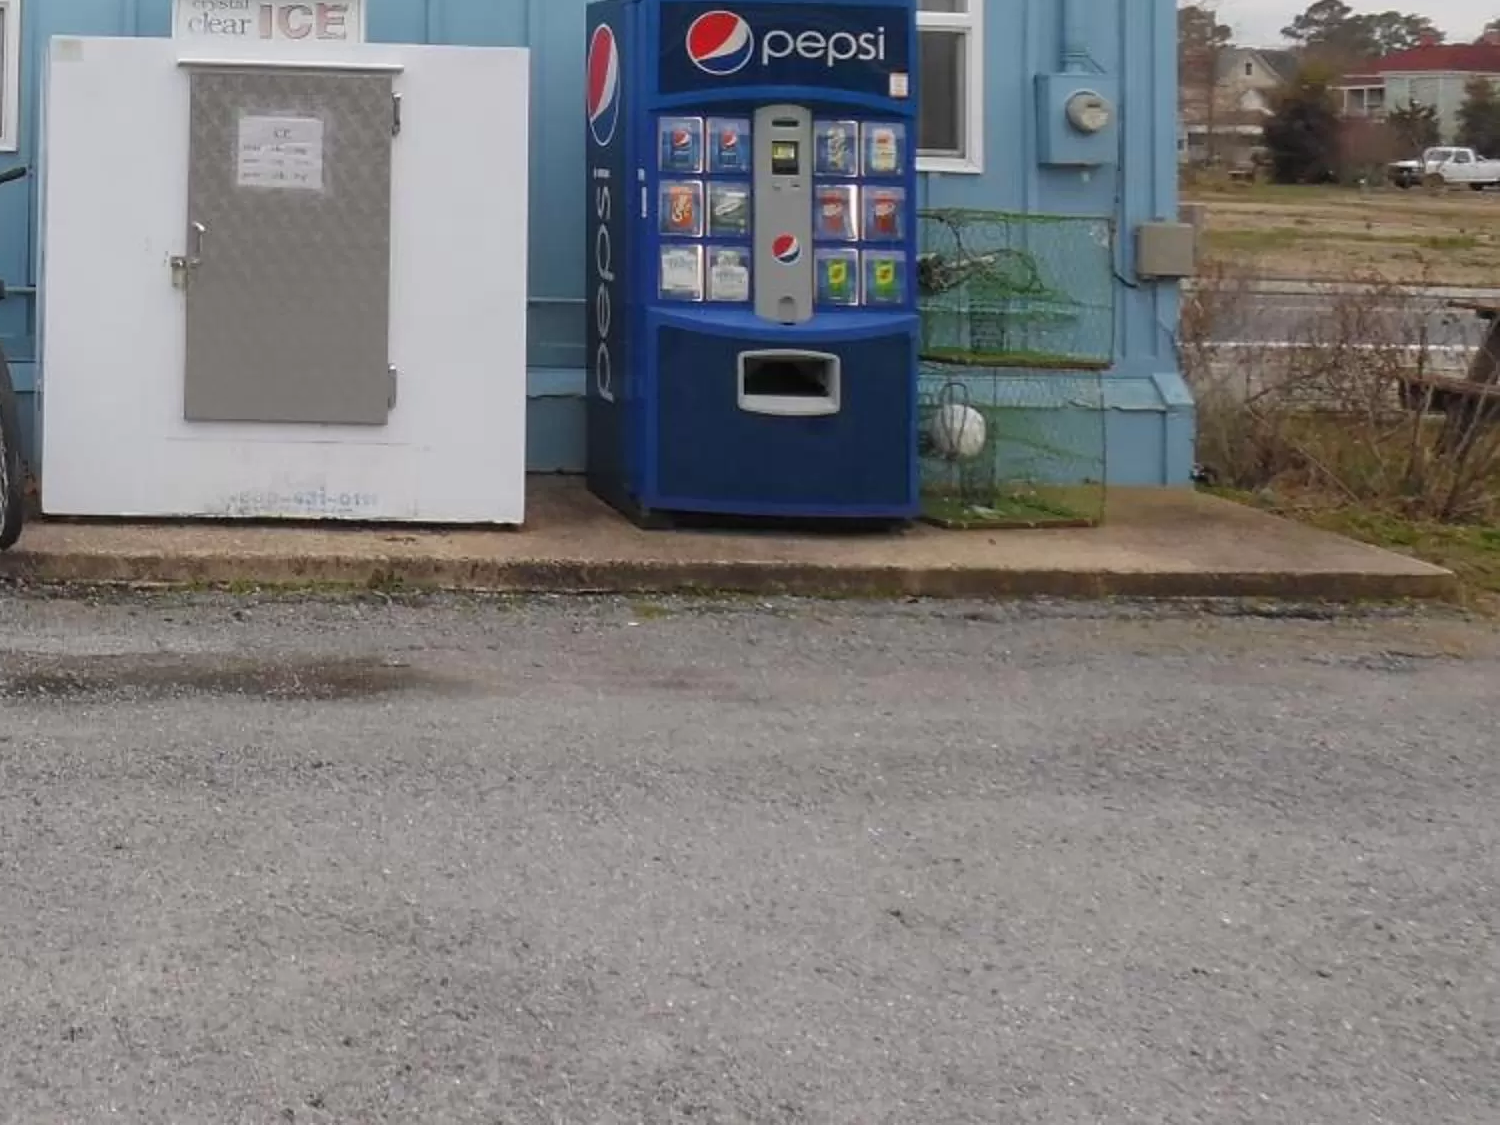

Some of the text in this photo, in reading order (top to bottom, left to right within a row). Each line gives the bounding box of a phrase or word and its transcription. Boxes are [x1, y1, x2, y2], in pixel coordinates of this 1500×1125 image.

[188, 11, 252, 36] clear
[259, 2, 348, 40] ICE
[761, 26, 885, 67] pepsi
[593, 167, 615, 403] pepsi
